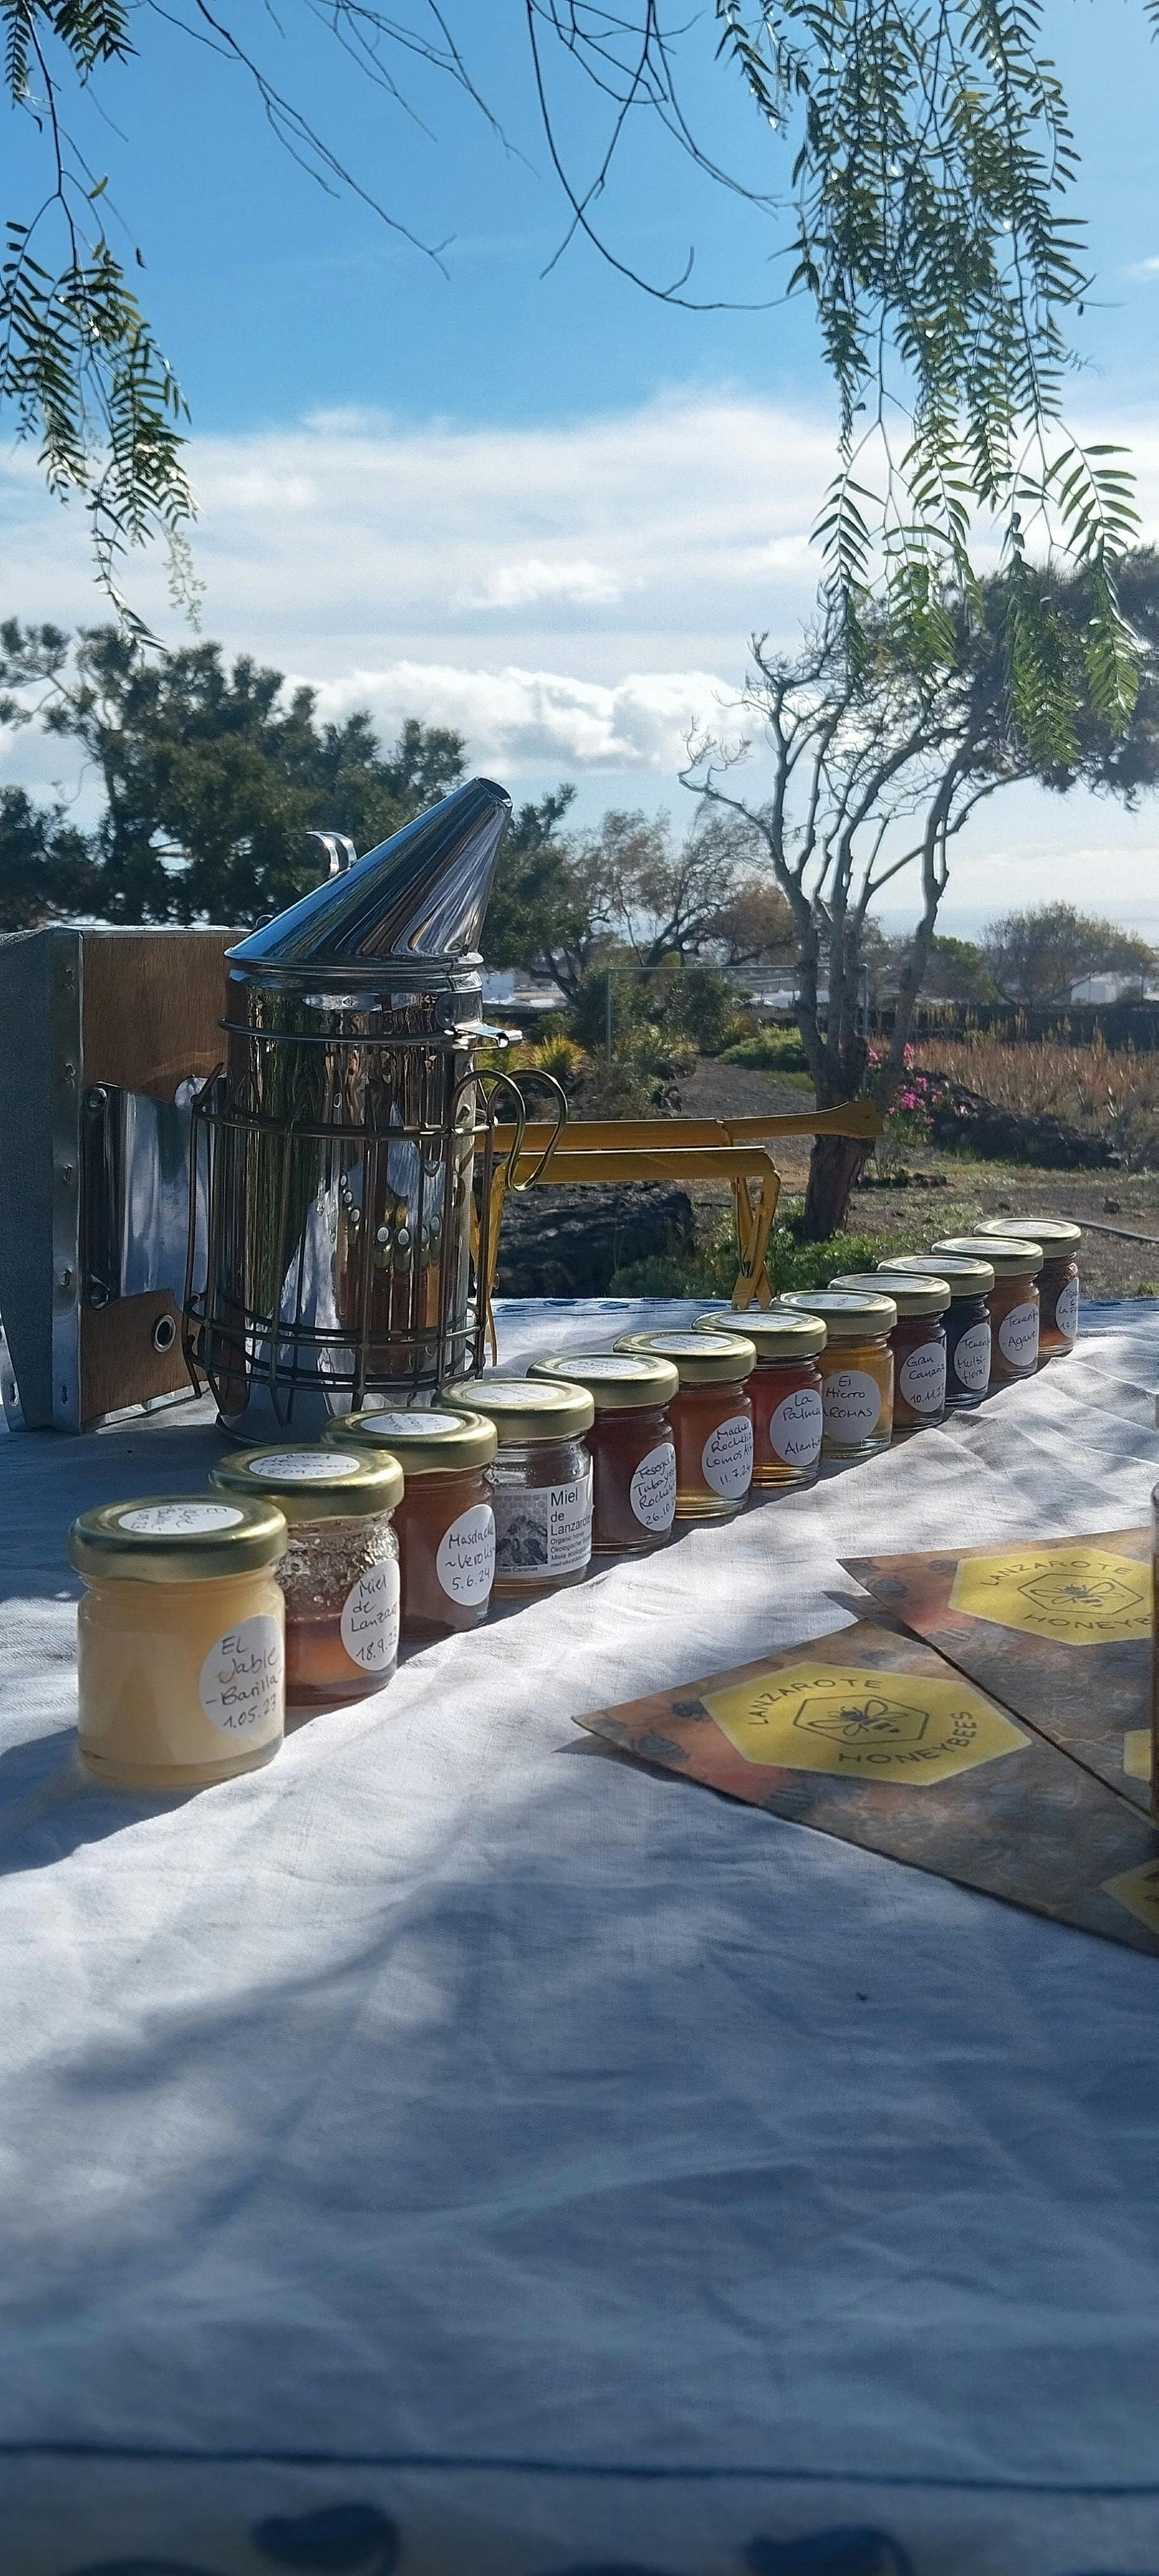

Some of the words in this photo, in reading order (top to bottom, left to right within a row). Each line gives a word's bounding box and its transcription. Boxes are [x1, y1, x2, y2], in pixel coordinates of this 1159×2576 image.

[906, 1356, 934, 1367] Gran
[794, 1395, 813, 1407] La
[826, 1387, 865, 1398] Hierro
[706, 1450, 742, 1468] Lomos
[550, 1487, 578, 1507] Miel
[550, 1511, 565, 1523] de
[550, 1515, 590, 1536] Lanzarote
[452, 1567, 490, 1590] 5.6.24
[980, 1561, 1132, 1587] LANZAROTE
[359, 1574, 387, 1598] Miel
[353, 1601, 375, 1613] de
[218, 1647, 278, 1684] Jable
[223, 1693, 276, 1729] 1.05.23
[748, 1678, 883, 1725] LANZAROTE
[839, 1711, 978, 1763] HONEYBEES
